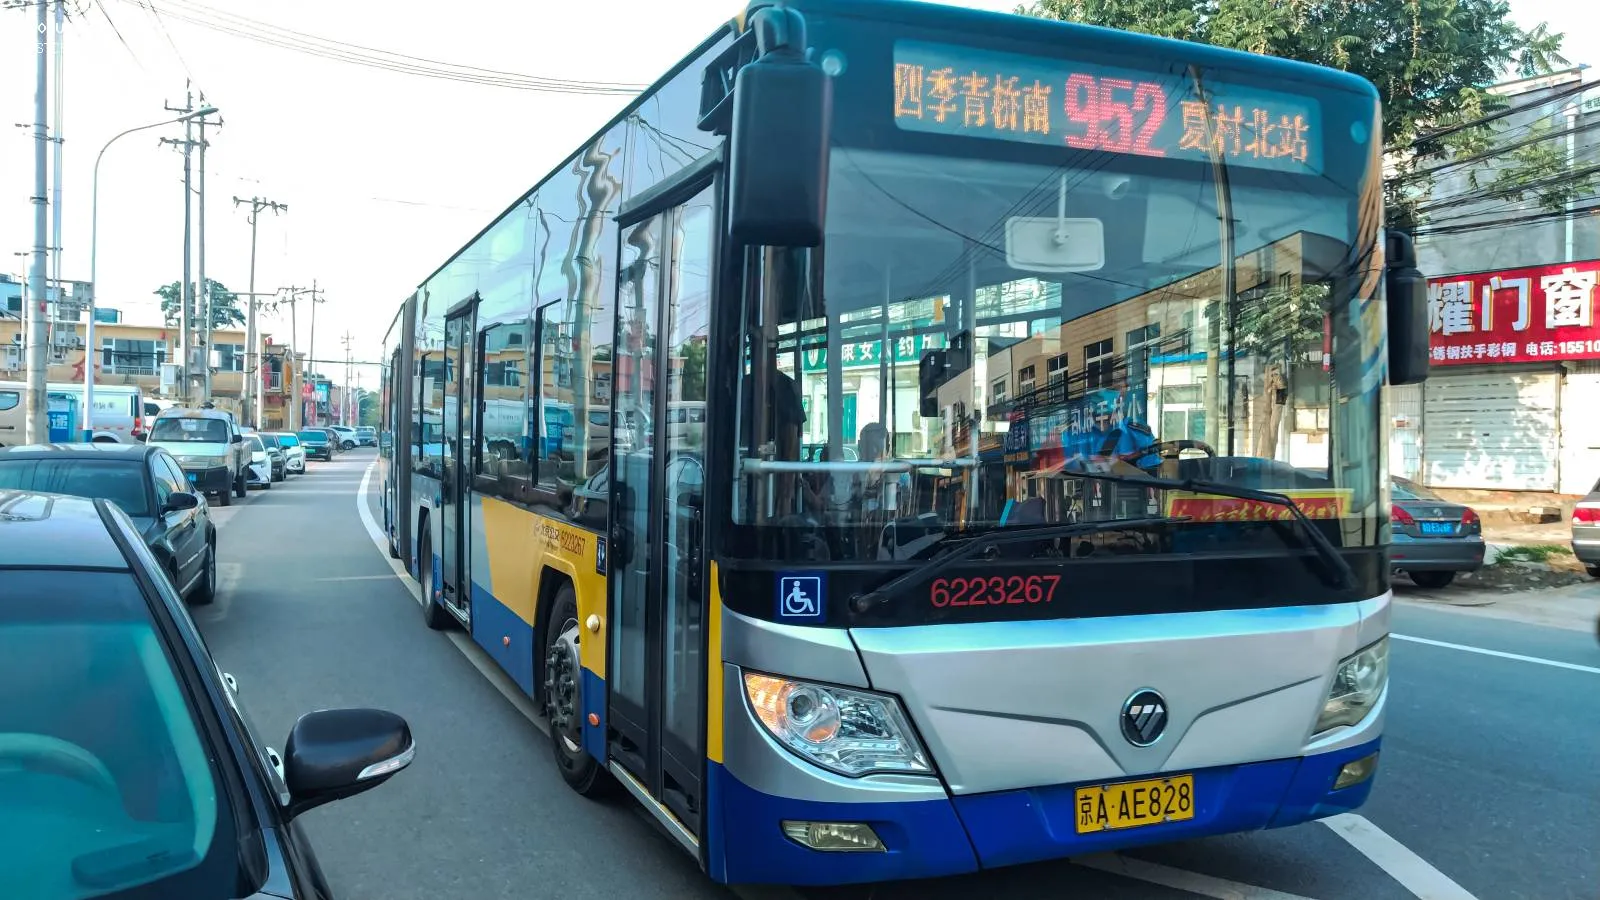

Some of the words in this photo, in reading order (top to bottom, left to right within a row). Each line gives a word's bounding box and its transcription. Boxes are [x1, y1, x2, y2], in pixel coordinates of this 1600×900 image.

[894, 63, 1052, 135] 四季青桥南
[1063, 72, 1167, 158] 952
[1179, 100, 1310, 163] 夏村北站
[1429, 342, 1517, 361] 锈钢扶手彩钢
[930, 575, 1062, 608] 6223267
